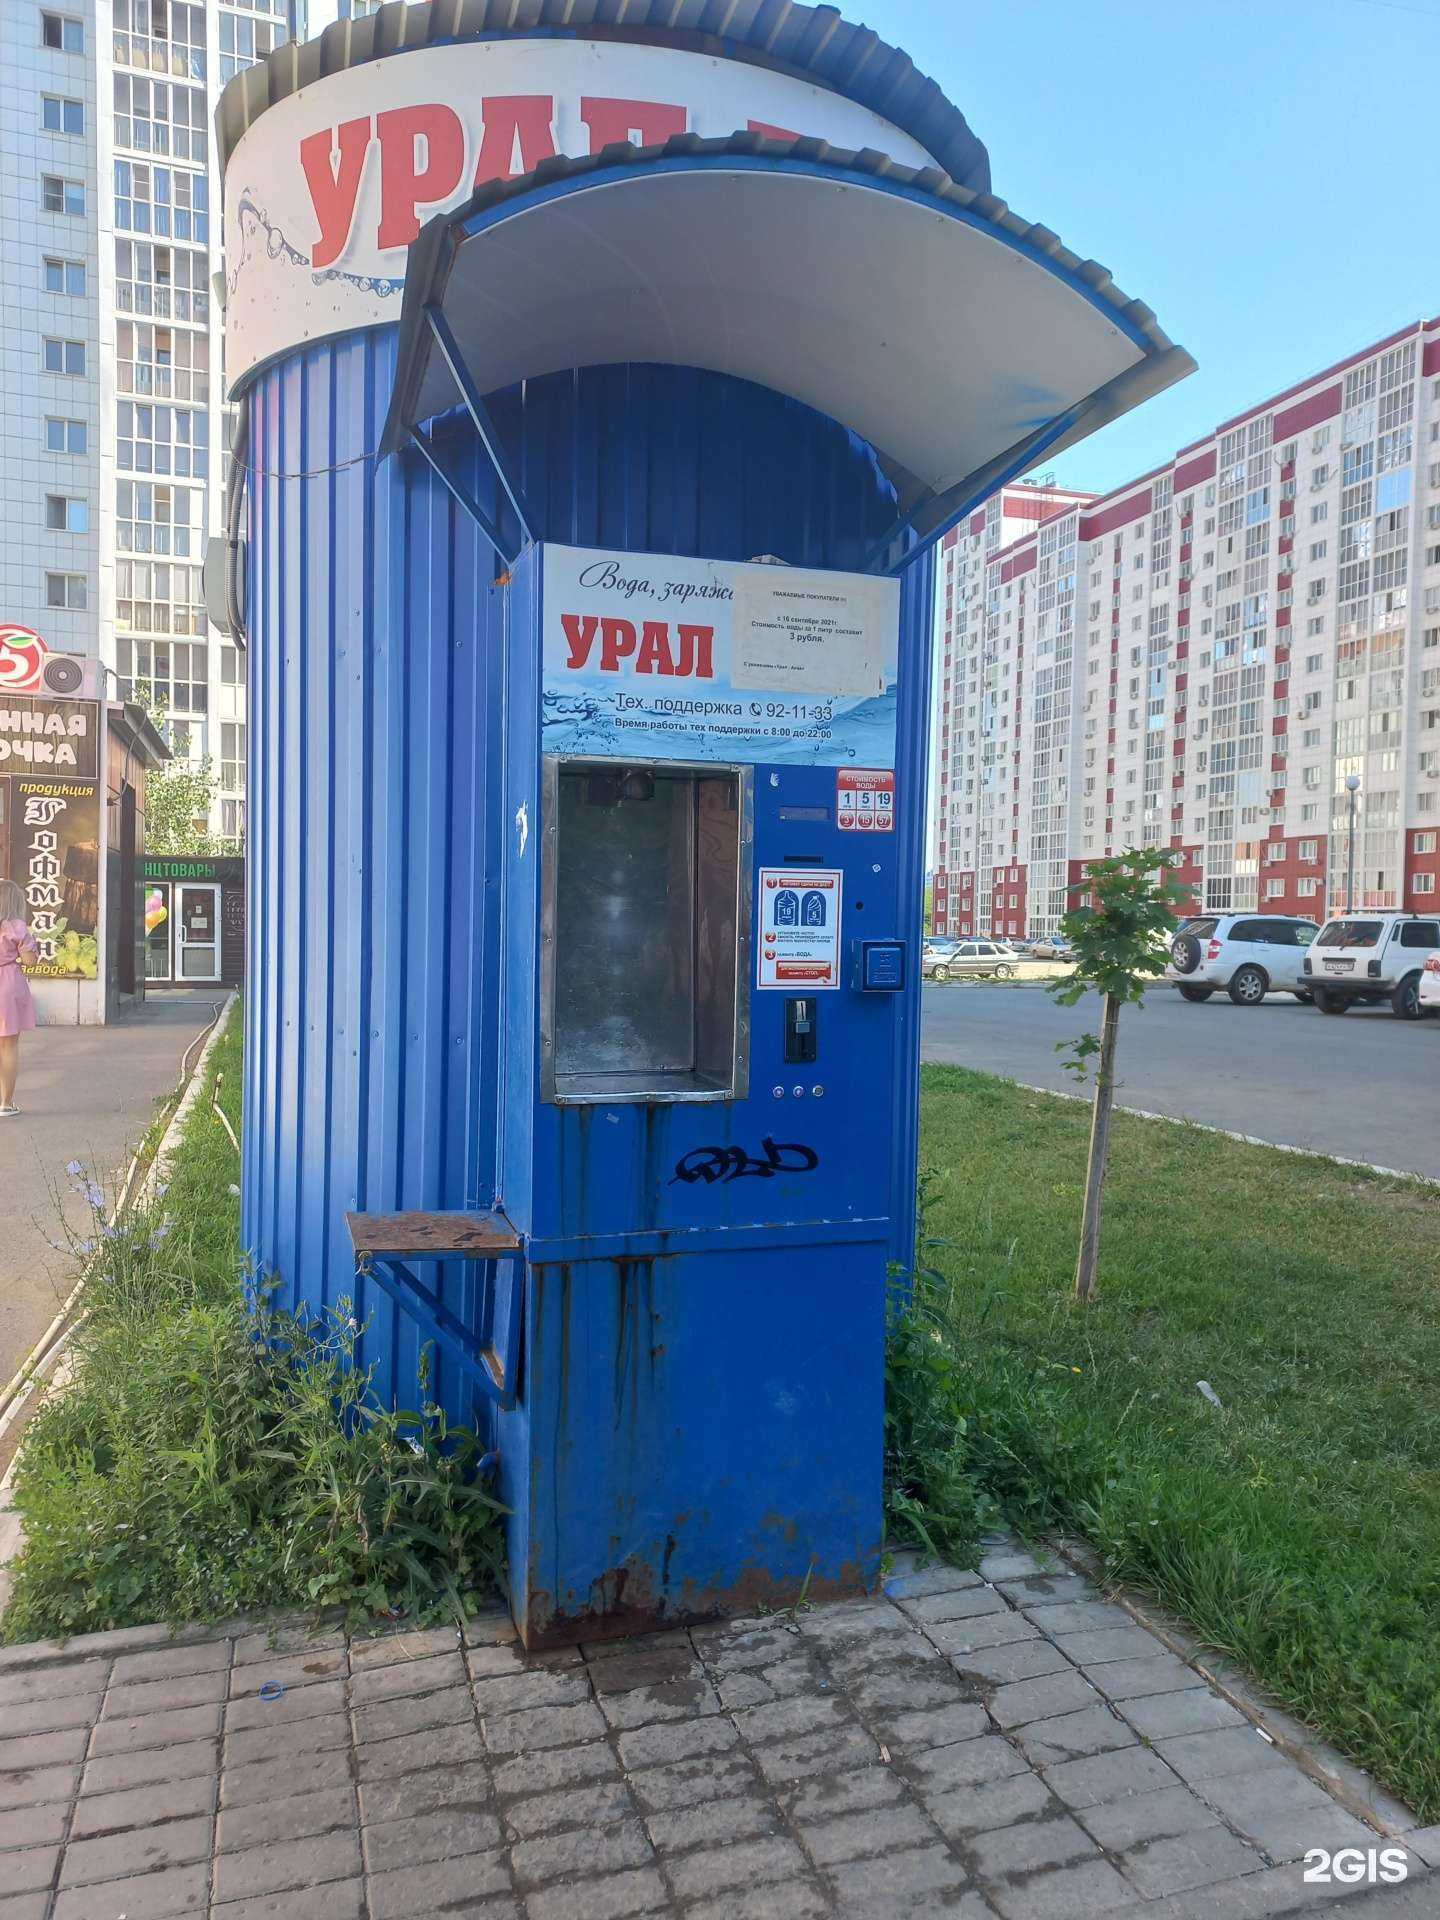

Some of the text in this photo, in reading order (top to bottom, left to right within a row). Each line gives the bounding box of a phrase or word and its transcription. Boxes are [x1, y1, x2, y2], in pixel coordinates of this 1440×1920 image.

[579, 560, 656, 599] Вода,
[751, 620, 785, 629] Стоимость
[786, 624, 804, 632] воды
[835, 628, 863, 636] составит
[790, 617, 819, 625] сентября
[789, 632, 795, 640] 3
[560, 613, 714, 679] УРАЛ
[615, 692, 833, 721] Тех. поддержка 92-11-33
[614, 717, 832, 740] Время работы тех поддержки с 8:00 до 22:00
[19, 783, 94, 797] продукция
[844, 792, 891, 805] 1 5 19
[144, 862, 216, 877] НЦТОВАРЫ
